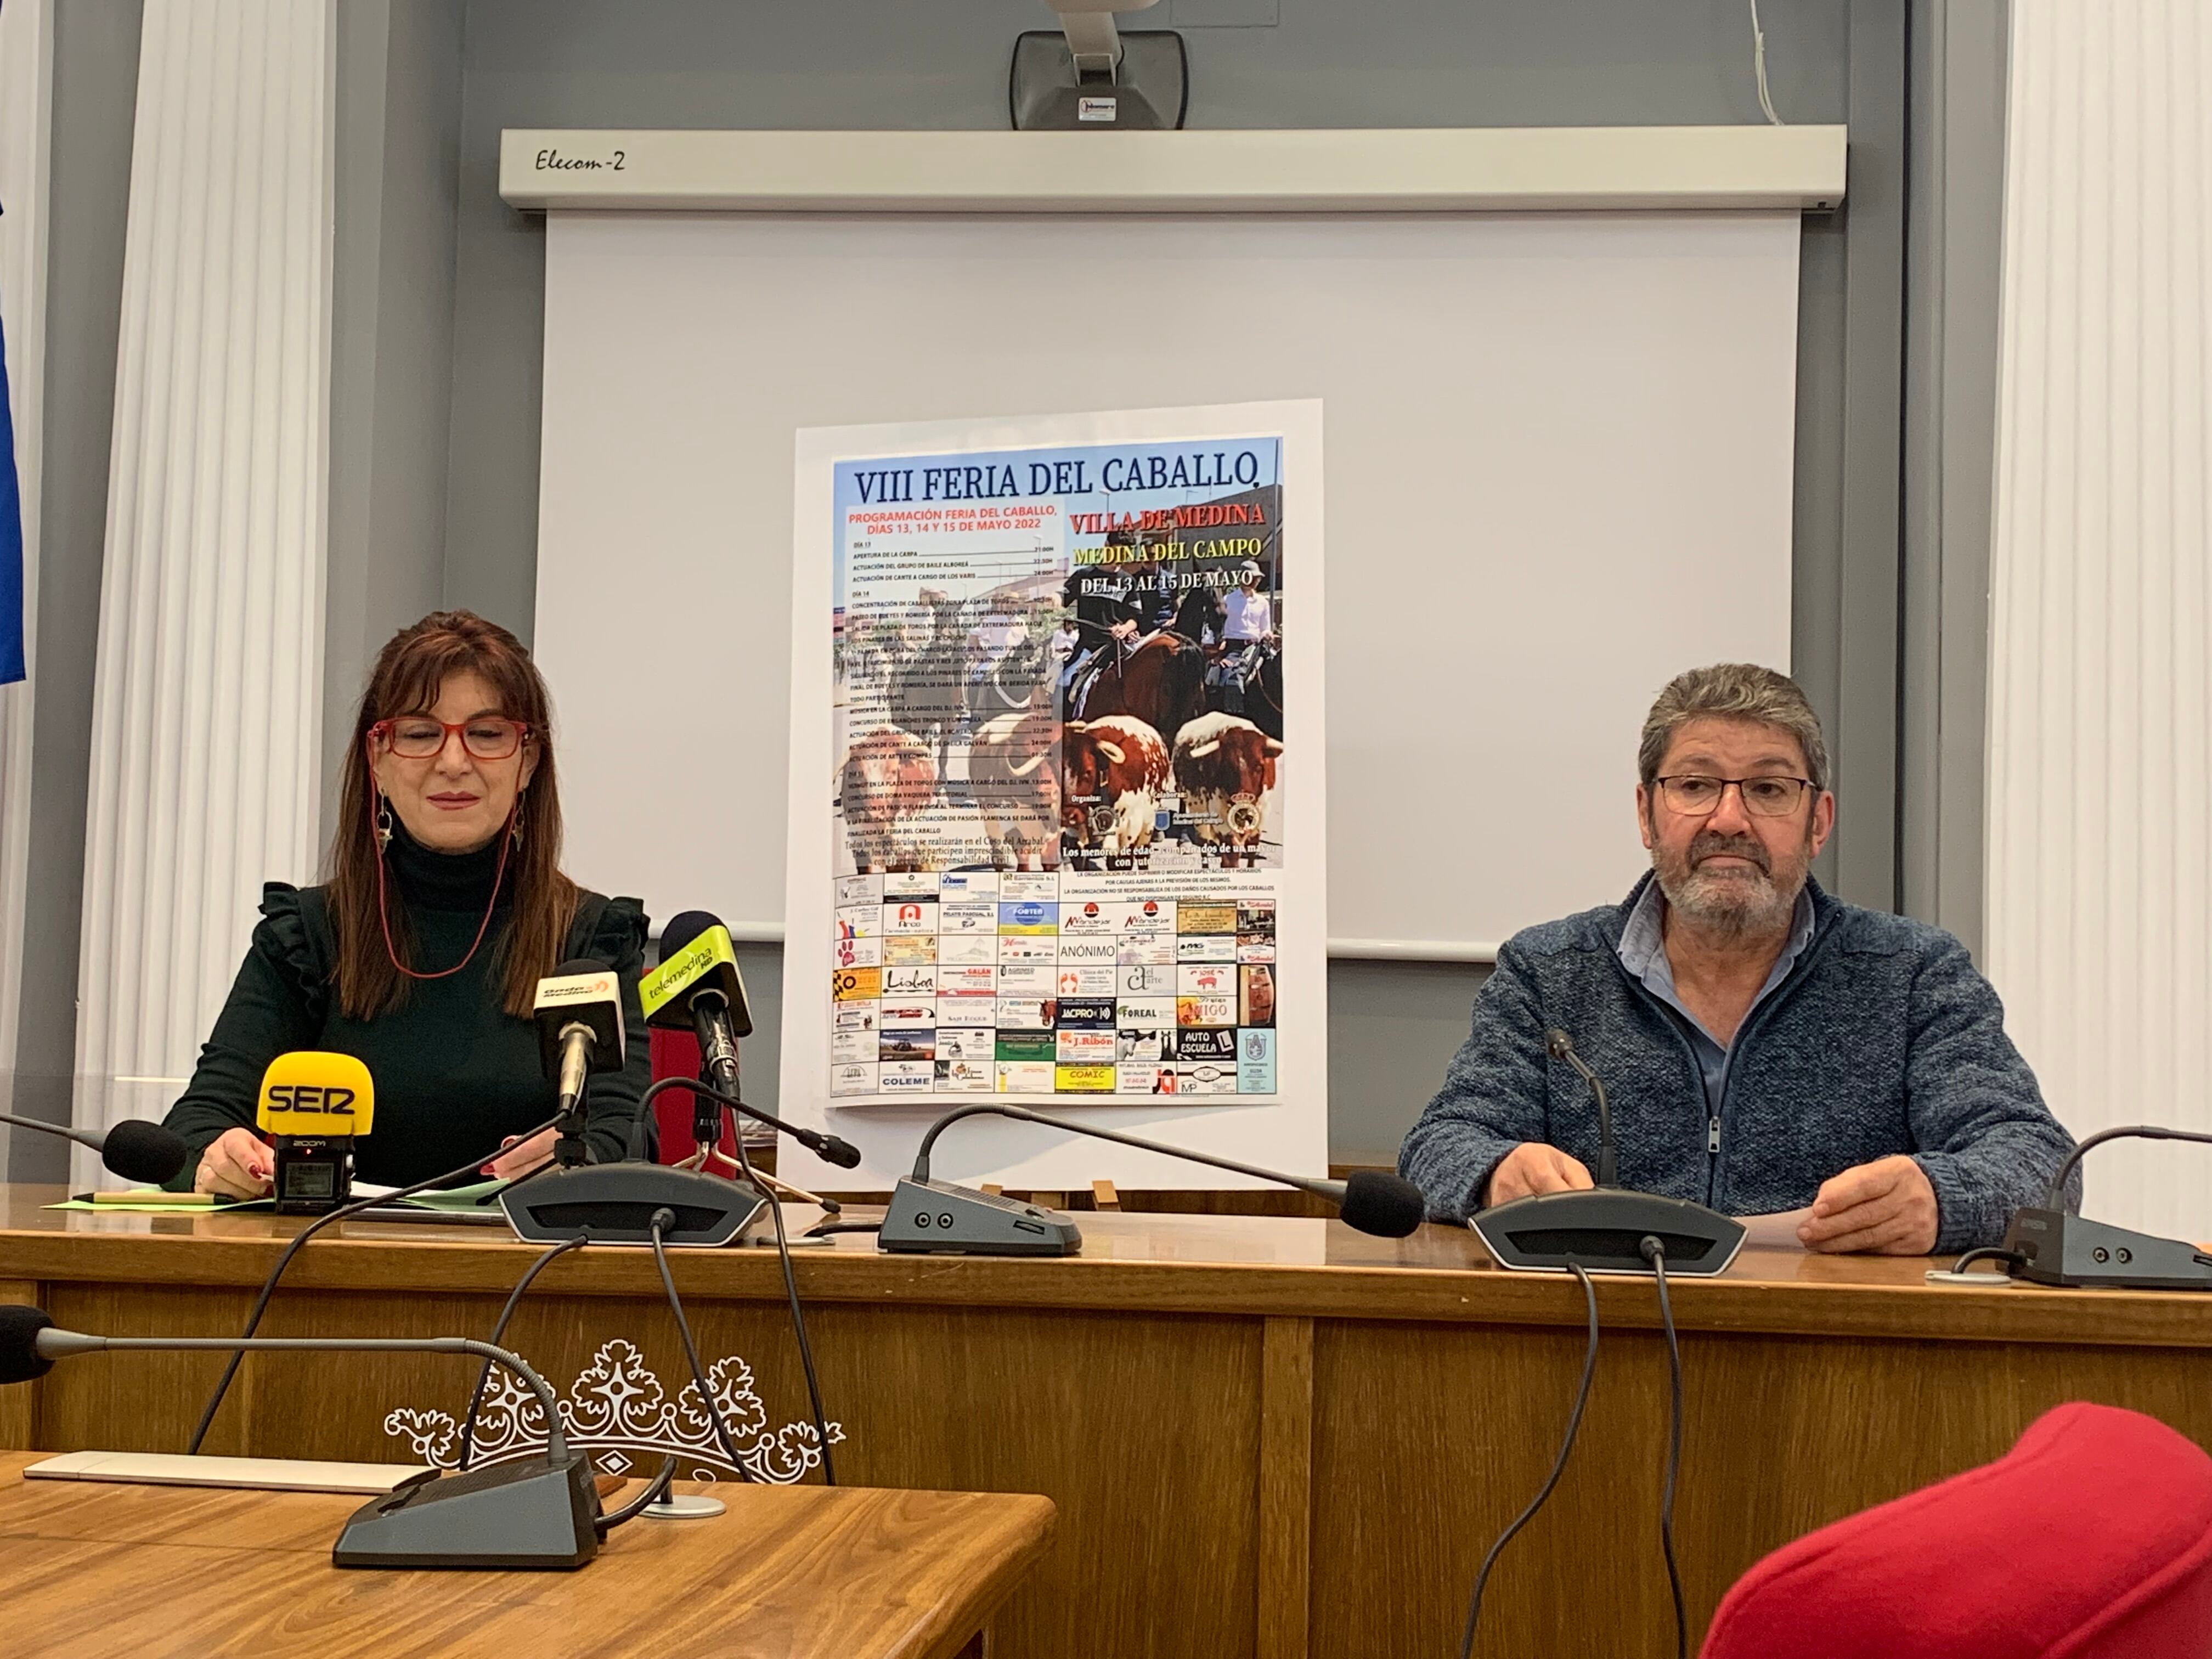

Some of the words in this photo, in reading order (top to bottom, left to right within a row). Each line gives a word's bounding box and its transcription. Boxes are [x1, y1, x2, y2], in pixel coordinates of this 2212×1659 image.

[536, 149, 625, 170] Elecom-2
[854, 470, 913, 504] VIII
[923, 465, 1020, 501] FERIA
[1029, 461, 1093, 495] DEL
[849, 509, 941, 523] PROGRAMACIÓN
[945, 509, 976, 519] FERIA
[980, 508, 1000, 518] DEL
[1003, 505, 1057, 517] CABALLO,
[1070, 510, 1137, 534] VILLA
[1140, 509, 1170, 531] DE
[1173, 503, 1266, 529] MEDINA
[867, 522, 893, 534] DÍAS
[898, 524, 912, 534] 13,
[917, 523, 929, 532] 14
[933, 523, 940, 532] Y
[944, 522, 955, 532] 15
[960, 522, 973, 532] DE
[977, 520, 1011, 531] MAYO
[1015, 518, 1041, 529] 2022
[1074, 544, 1149, 566] MEDINA
[1154, 541, 1190, 561] DEL
[1194, 537, 1261, 559] CAMPO
[853, 562, 884, 571] ACTUACIÓN
[853, 574, 884, 582] ACTUACIÓN
[1081, 577, 1113, 594] DEL
[1116, 577, 1133, 592] 13
[1136, 576, 1158, 591] AL
[1162, 574, 1177, 589] 15
[1181, 573, 1203, 589] DE
[1207, 569, 1254, 588] MAYO
[928, 837, 963, 845] realizarán
[1063, 847, 1079, 857] Los
[1121, 846, 1132, 855] de
[1220, 843, 1231, 853] de
[1115, 858, 1132, 867] con
[1060, 943, 1115, 957] ANÓNIMO
[701, 956, 714, 970] HD
[649, 947, 712, 1000] telemedina
[887, 970, 934, 989] Lisboa
[1185, 1032, 1210, 1042] AUTO
[1181, 1043, 1217, 1053] ESCUELA
[882, 1077, 930, 1086] COLEME
[267, 1085, 356, 1115] SER
